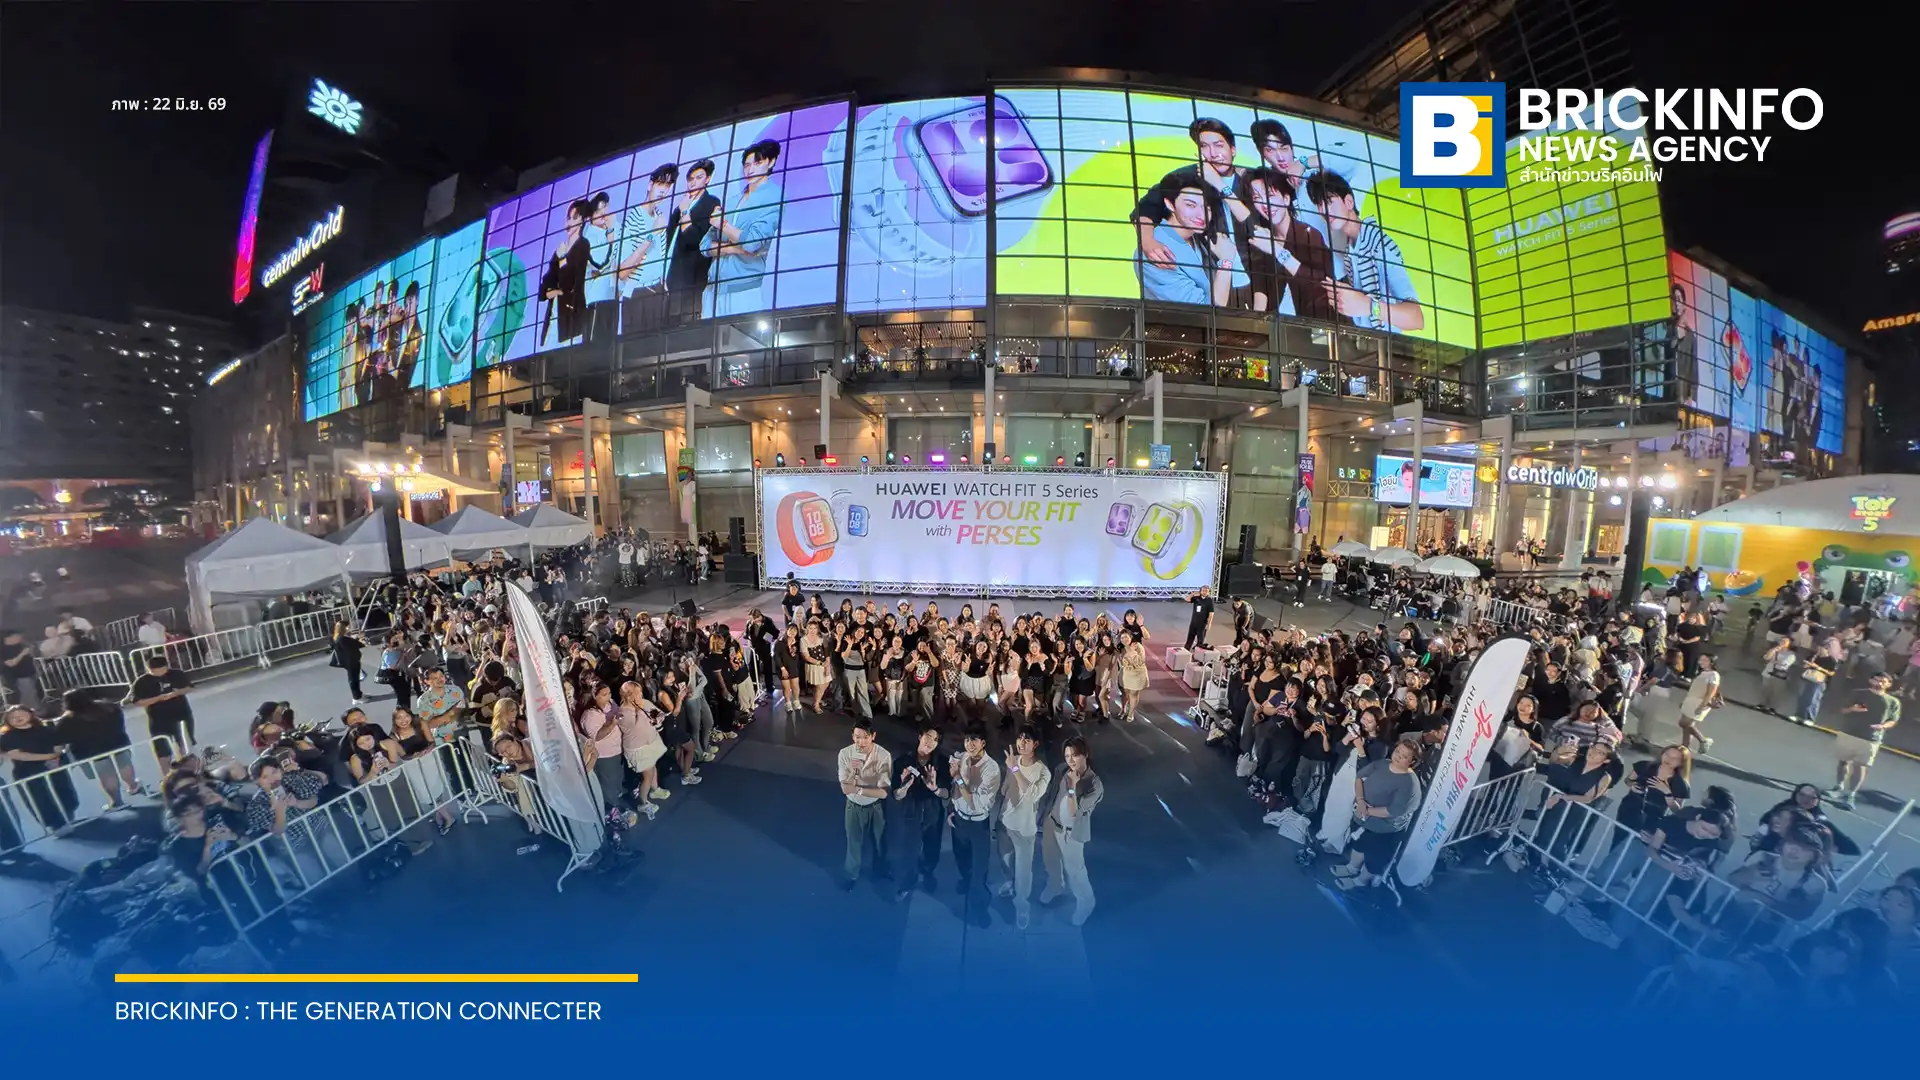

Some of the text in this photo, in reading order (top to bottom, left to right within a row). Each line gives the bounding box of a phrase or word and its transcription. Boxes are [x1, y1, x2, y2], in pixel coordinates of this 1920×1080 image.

[1494, 191, 1613, 243] HUAWEI
[1496, 237, 1541, 256] WATCH
[1579, 214, 1618, 231] Series
[876, 482, 1099, 499] HUAWEI WATCH FIT 5 Series
[891, 499, 1082, 523] MOVE YOUR FIT
[1851, 496, 1897, 511] TOY
[806, 511, 821, 524] 10
[850, 512, 860, 521] 10
[1862, 517, 1879, 532] 5
[808, 523, 825, 537] 08
[925, 524, 1043, 546] with PERSES
[1454, 685, 1476, 741] HUAWEI
